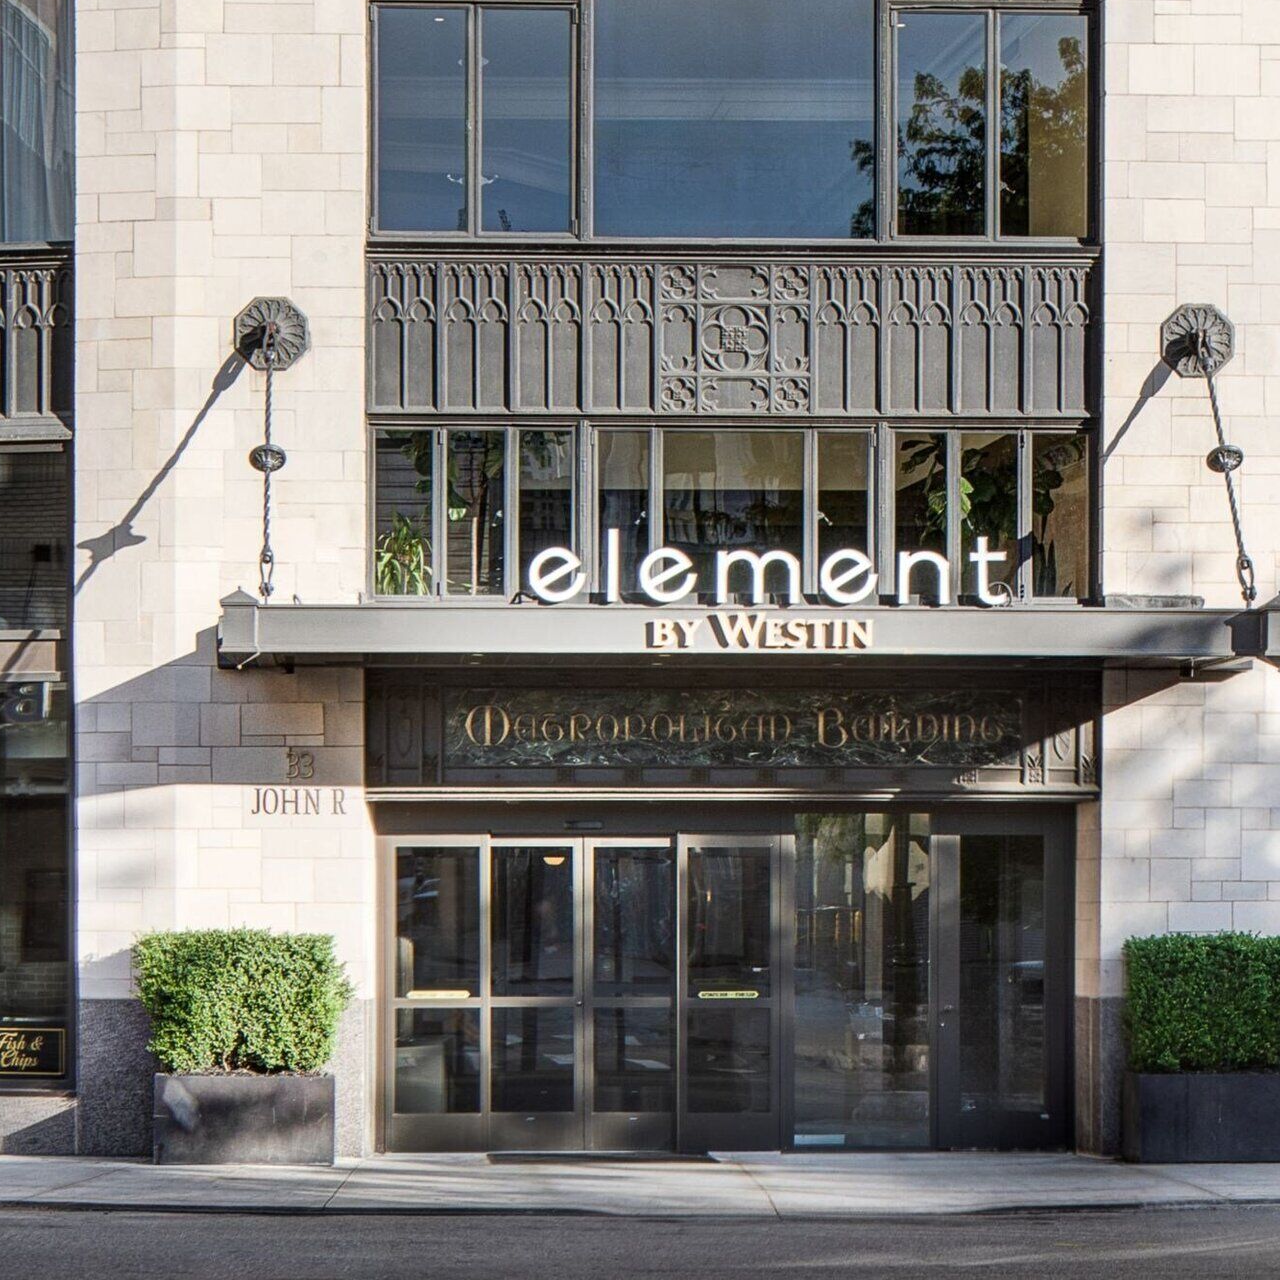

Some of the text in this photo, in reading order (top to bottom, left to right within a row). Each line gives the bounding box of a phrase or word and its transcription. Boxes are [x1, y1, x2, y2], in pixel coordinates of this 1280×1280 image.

[529, 528, 1007, 605] element
[650, 612, 873, 649] BY WESTIN
[251, 788, 347, 815] JOHN R
[30, 1035, 44, 1051] &
[0, 1050, 39, 1070] Chips
